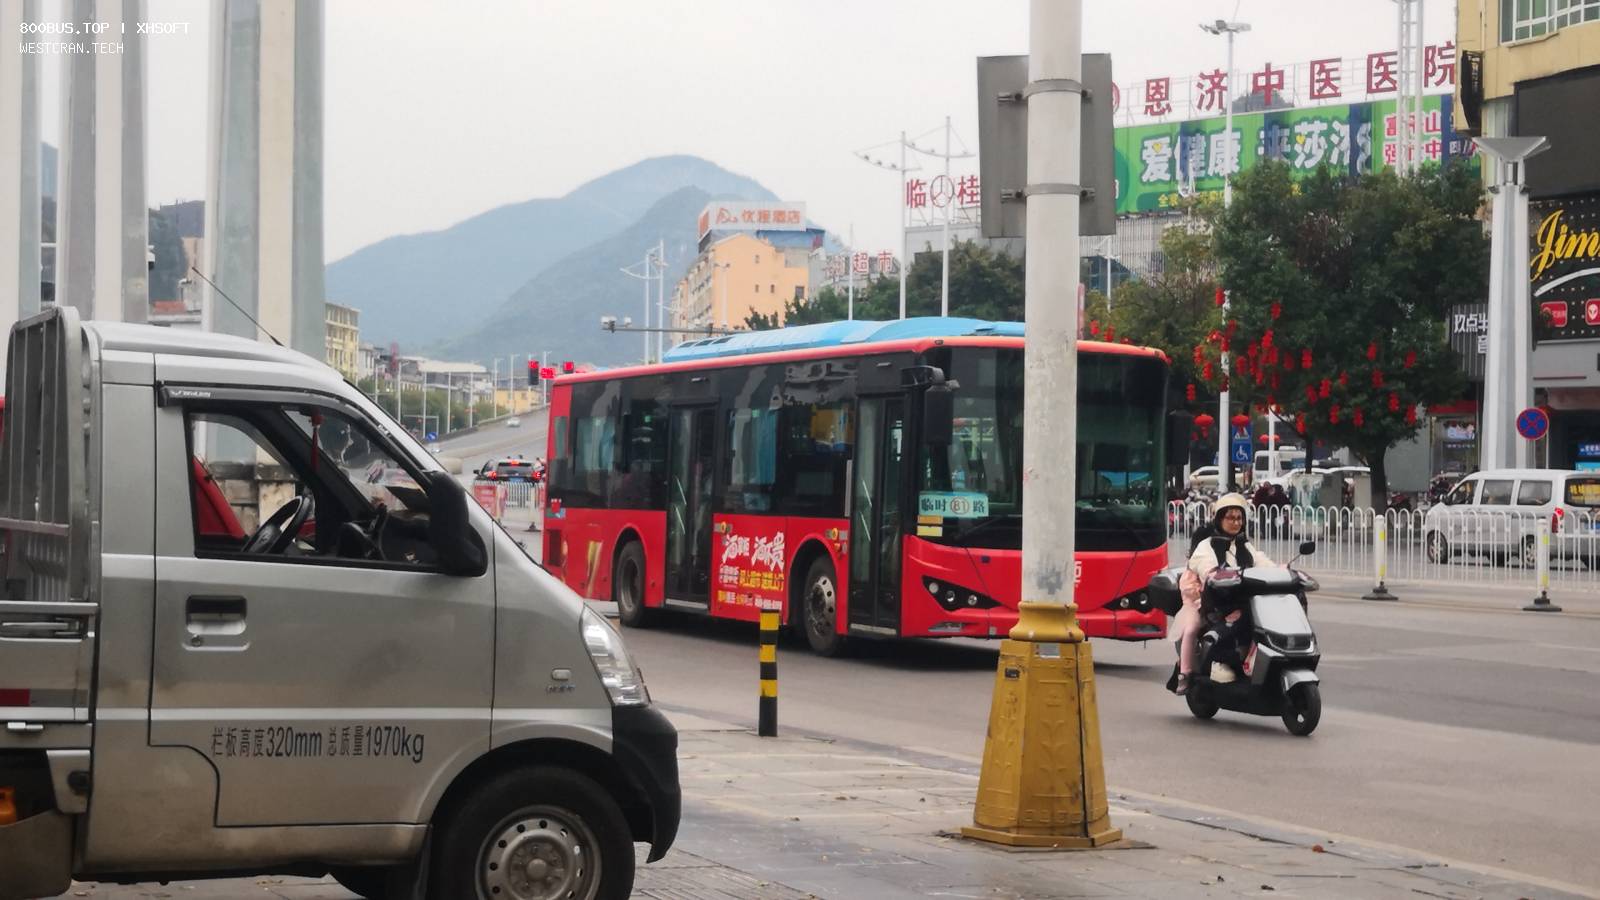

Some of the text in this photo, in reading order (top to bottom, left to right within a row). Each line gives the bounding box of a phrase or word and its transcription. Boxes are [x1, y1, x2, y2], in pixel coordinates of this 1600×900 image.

[1144, 41, 1456, 116] 恩济中医医院
[211, 725, 425, 763] 栏板高度320mm 总质量1970kg
